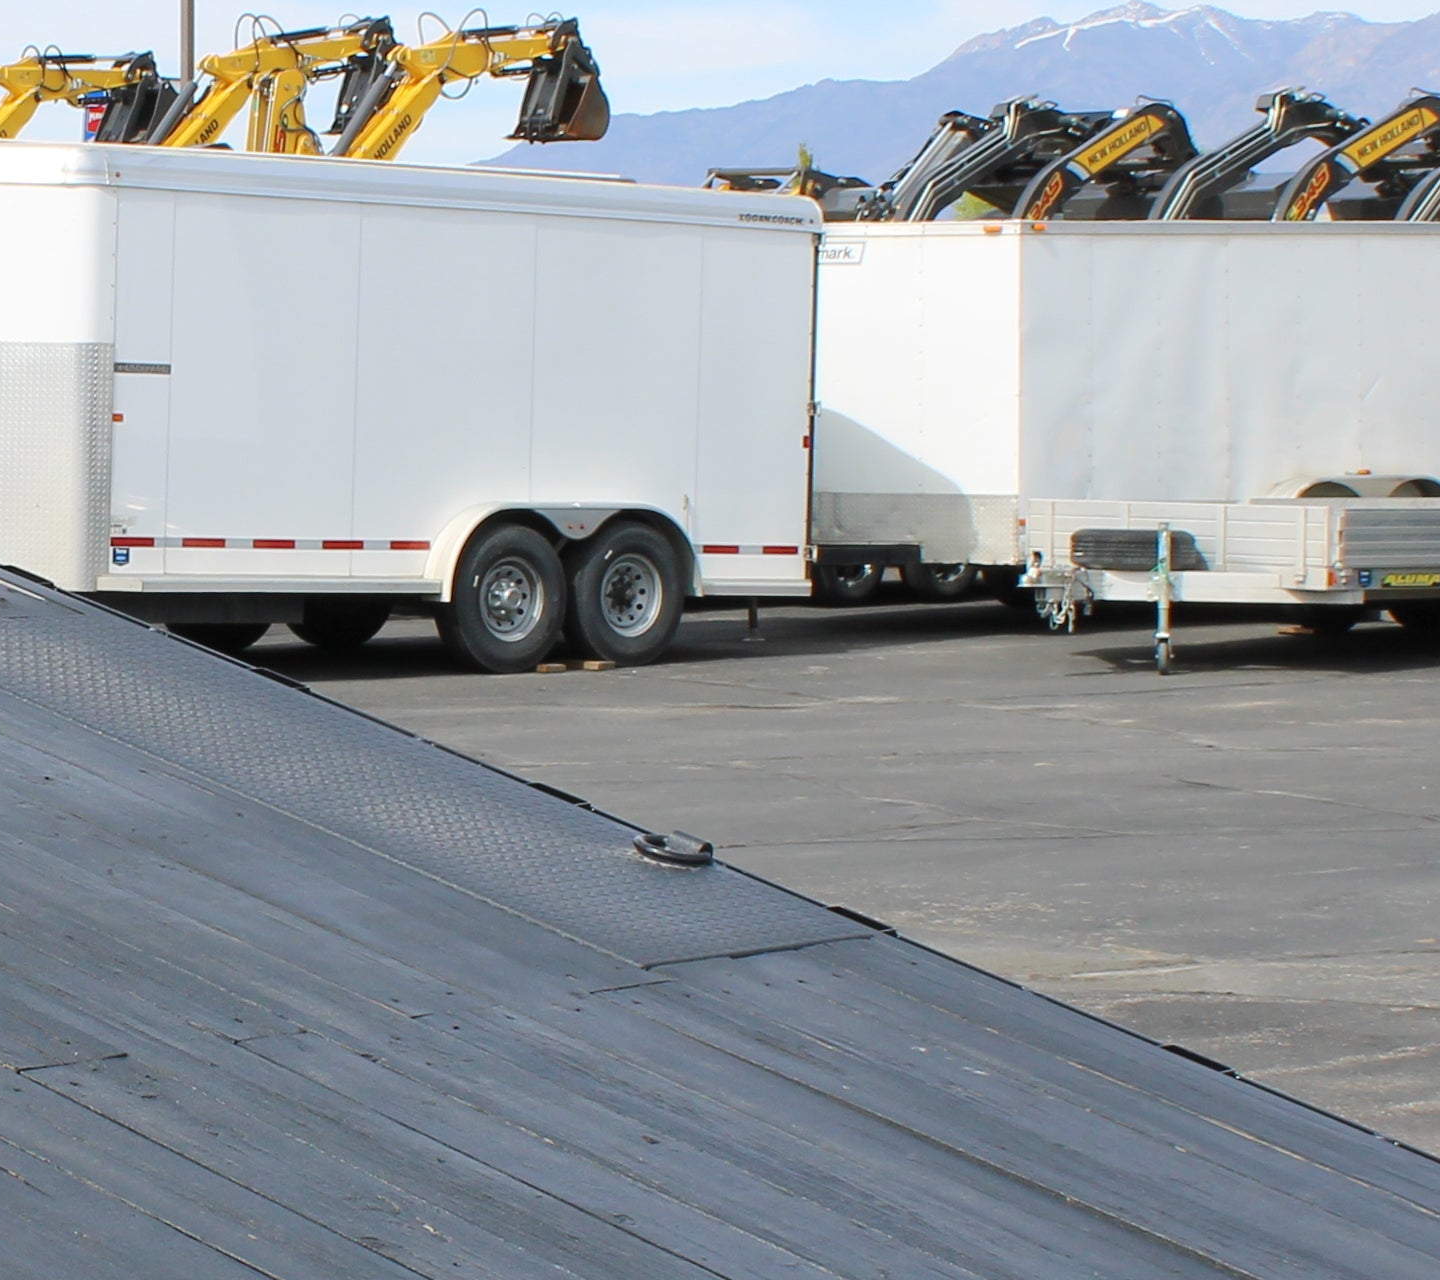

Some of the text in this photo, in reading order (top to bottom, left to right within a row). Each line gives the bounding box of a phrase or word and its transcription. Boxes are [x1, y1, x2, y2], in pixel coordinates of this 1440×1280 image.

[1087, 121, 1147, 166] NEW HOLLAND
[1356, 114, 1420, 160] NEW HOLLAND
